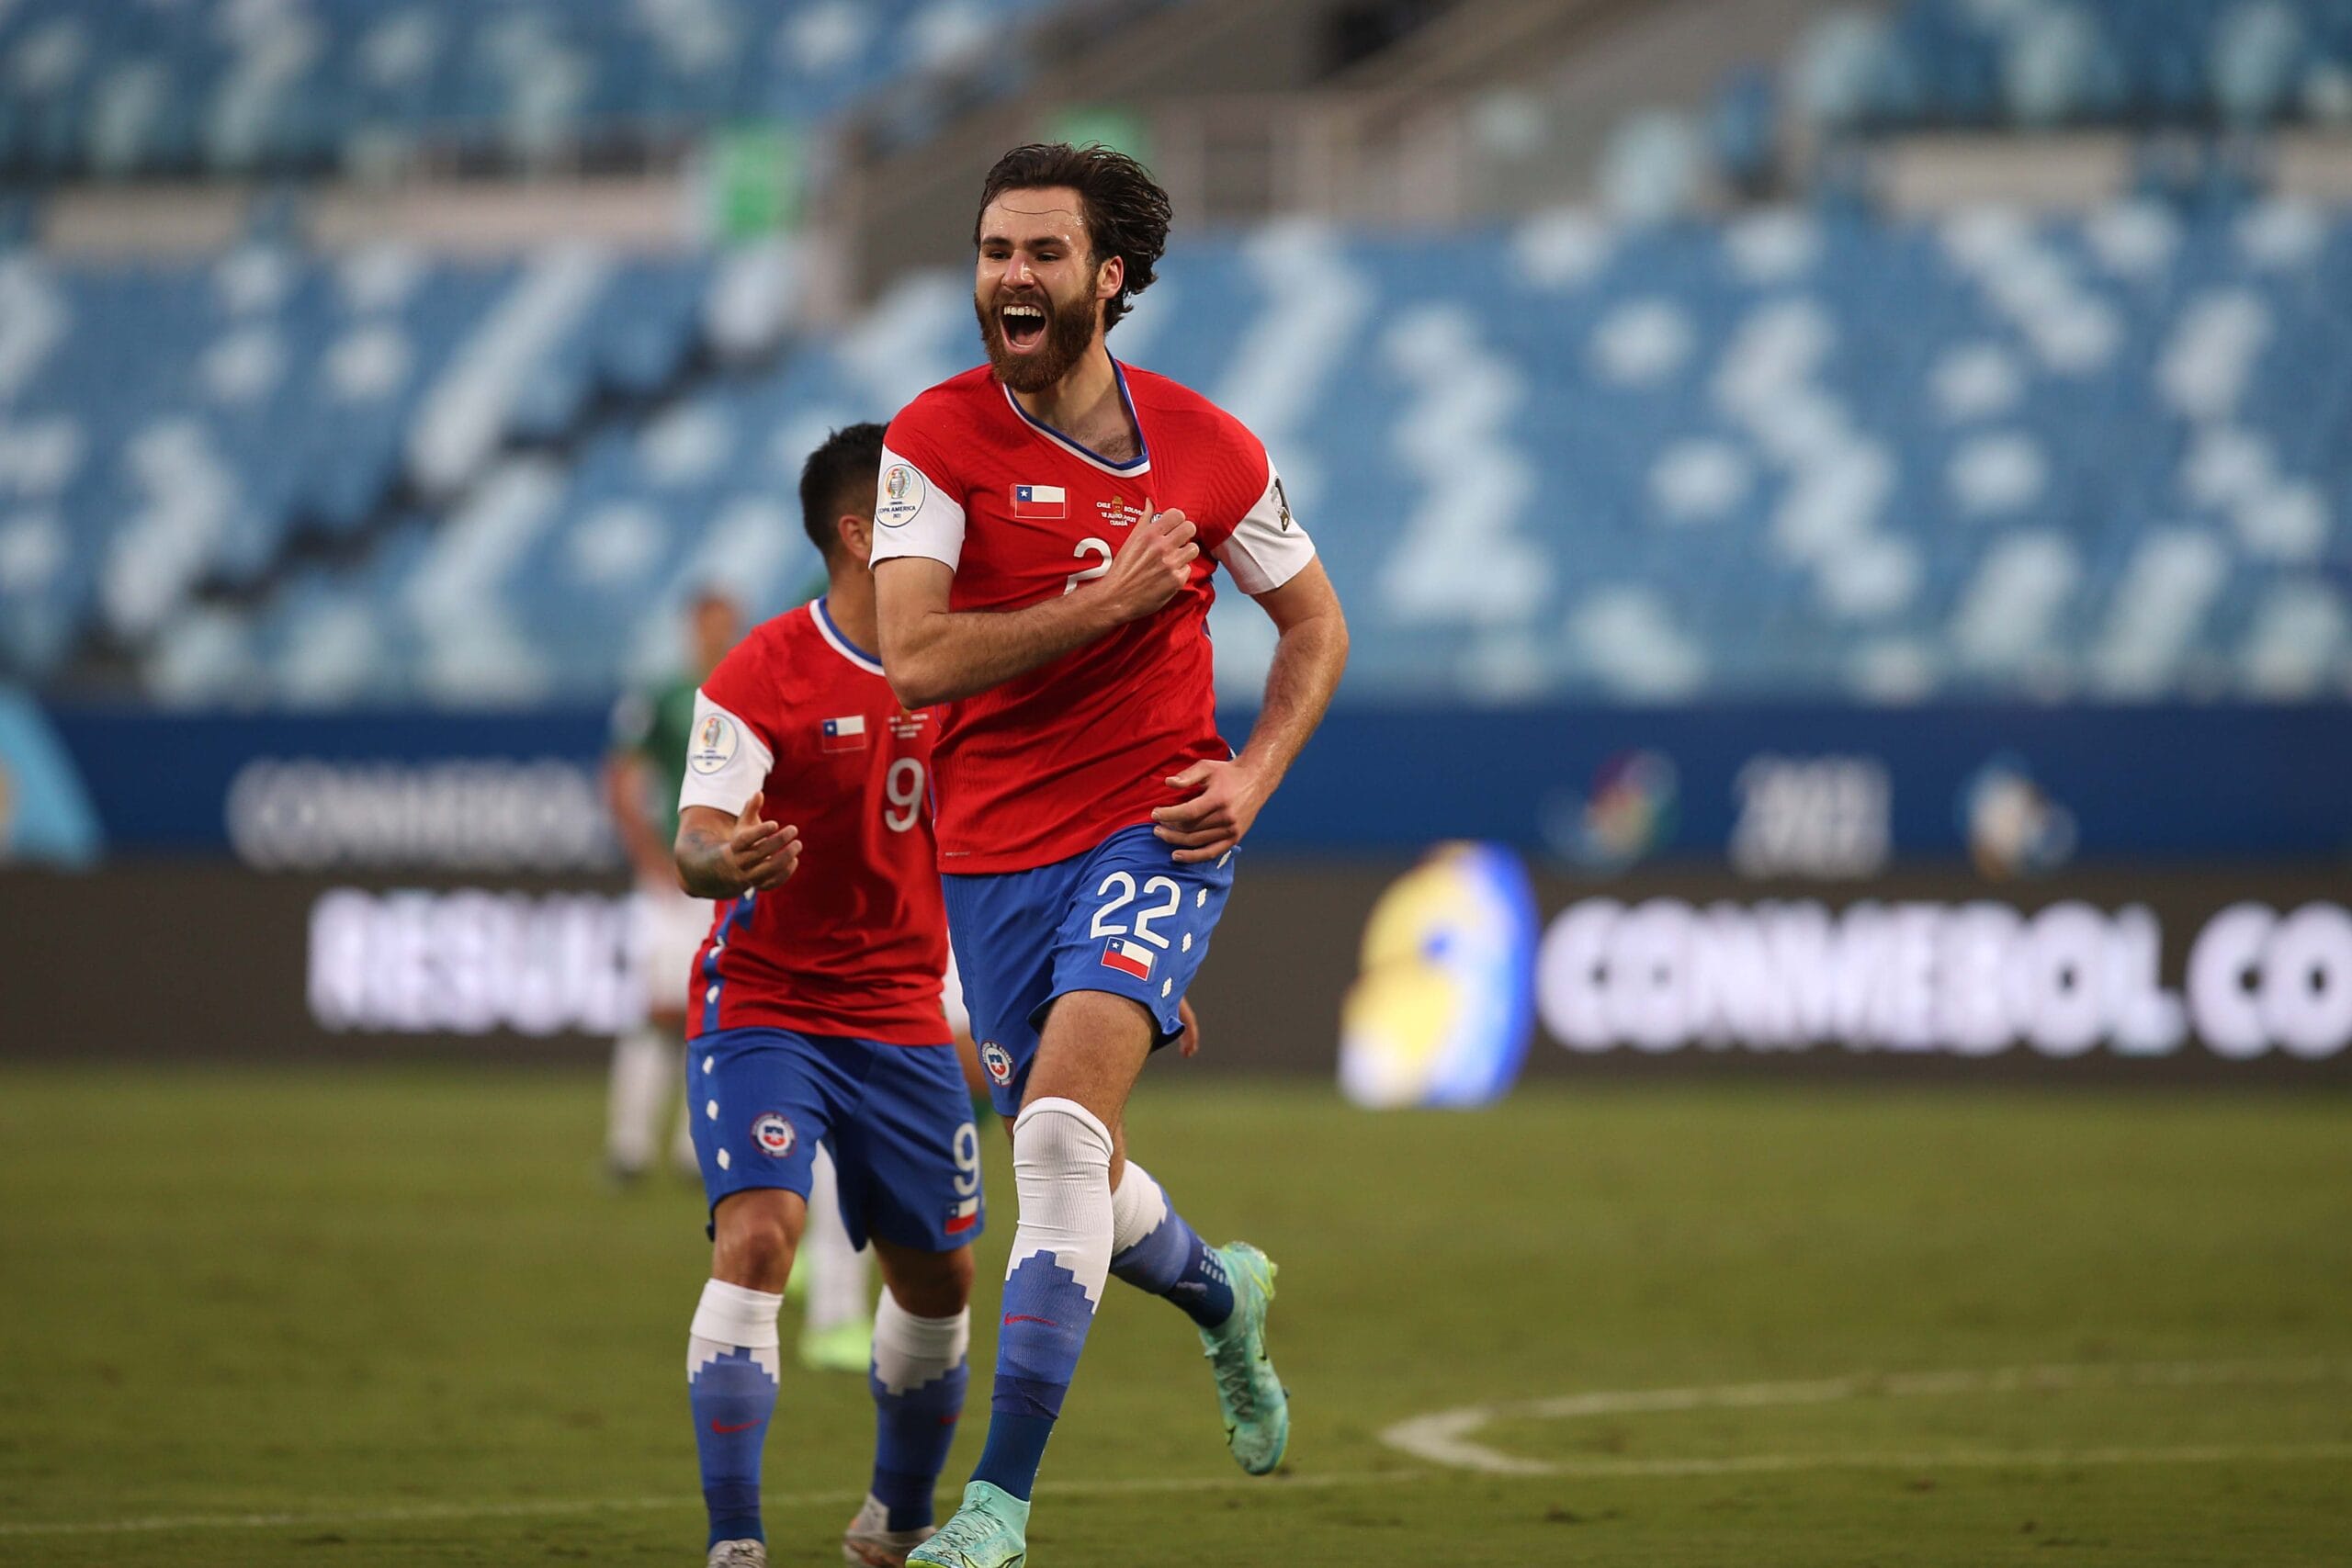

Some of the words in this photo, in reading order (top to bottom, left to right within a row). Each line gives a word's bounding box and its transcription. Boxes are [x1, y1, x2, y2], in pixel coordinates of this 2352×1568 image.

[1063, 536, 1113, 595] 2
[885, 757, 925, 832] 9
[1090, 871, 1182, 950] 22
[953, 1122, 982, 1196] 9
